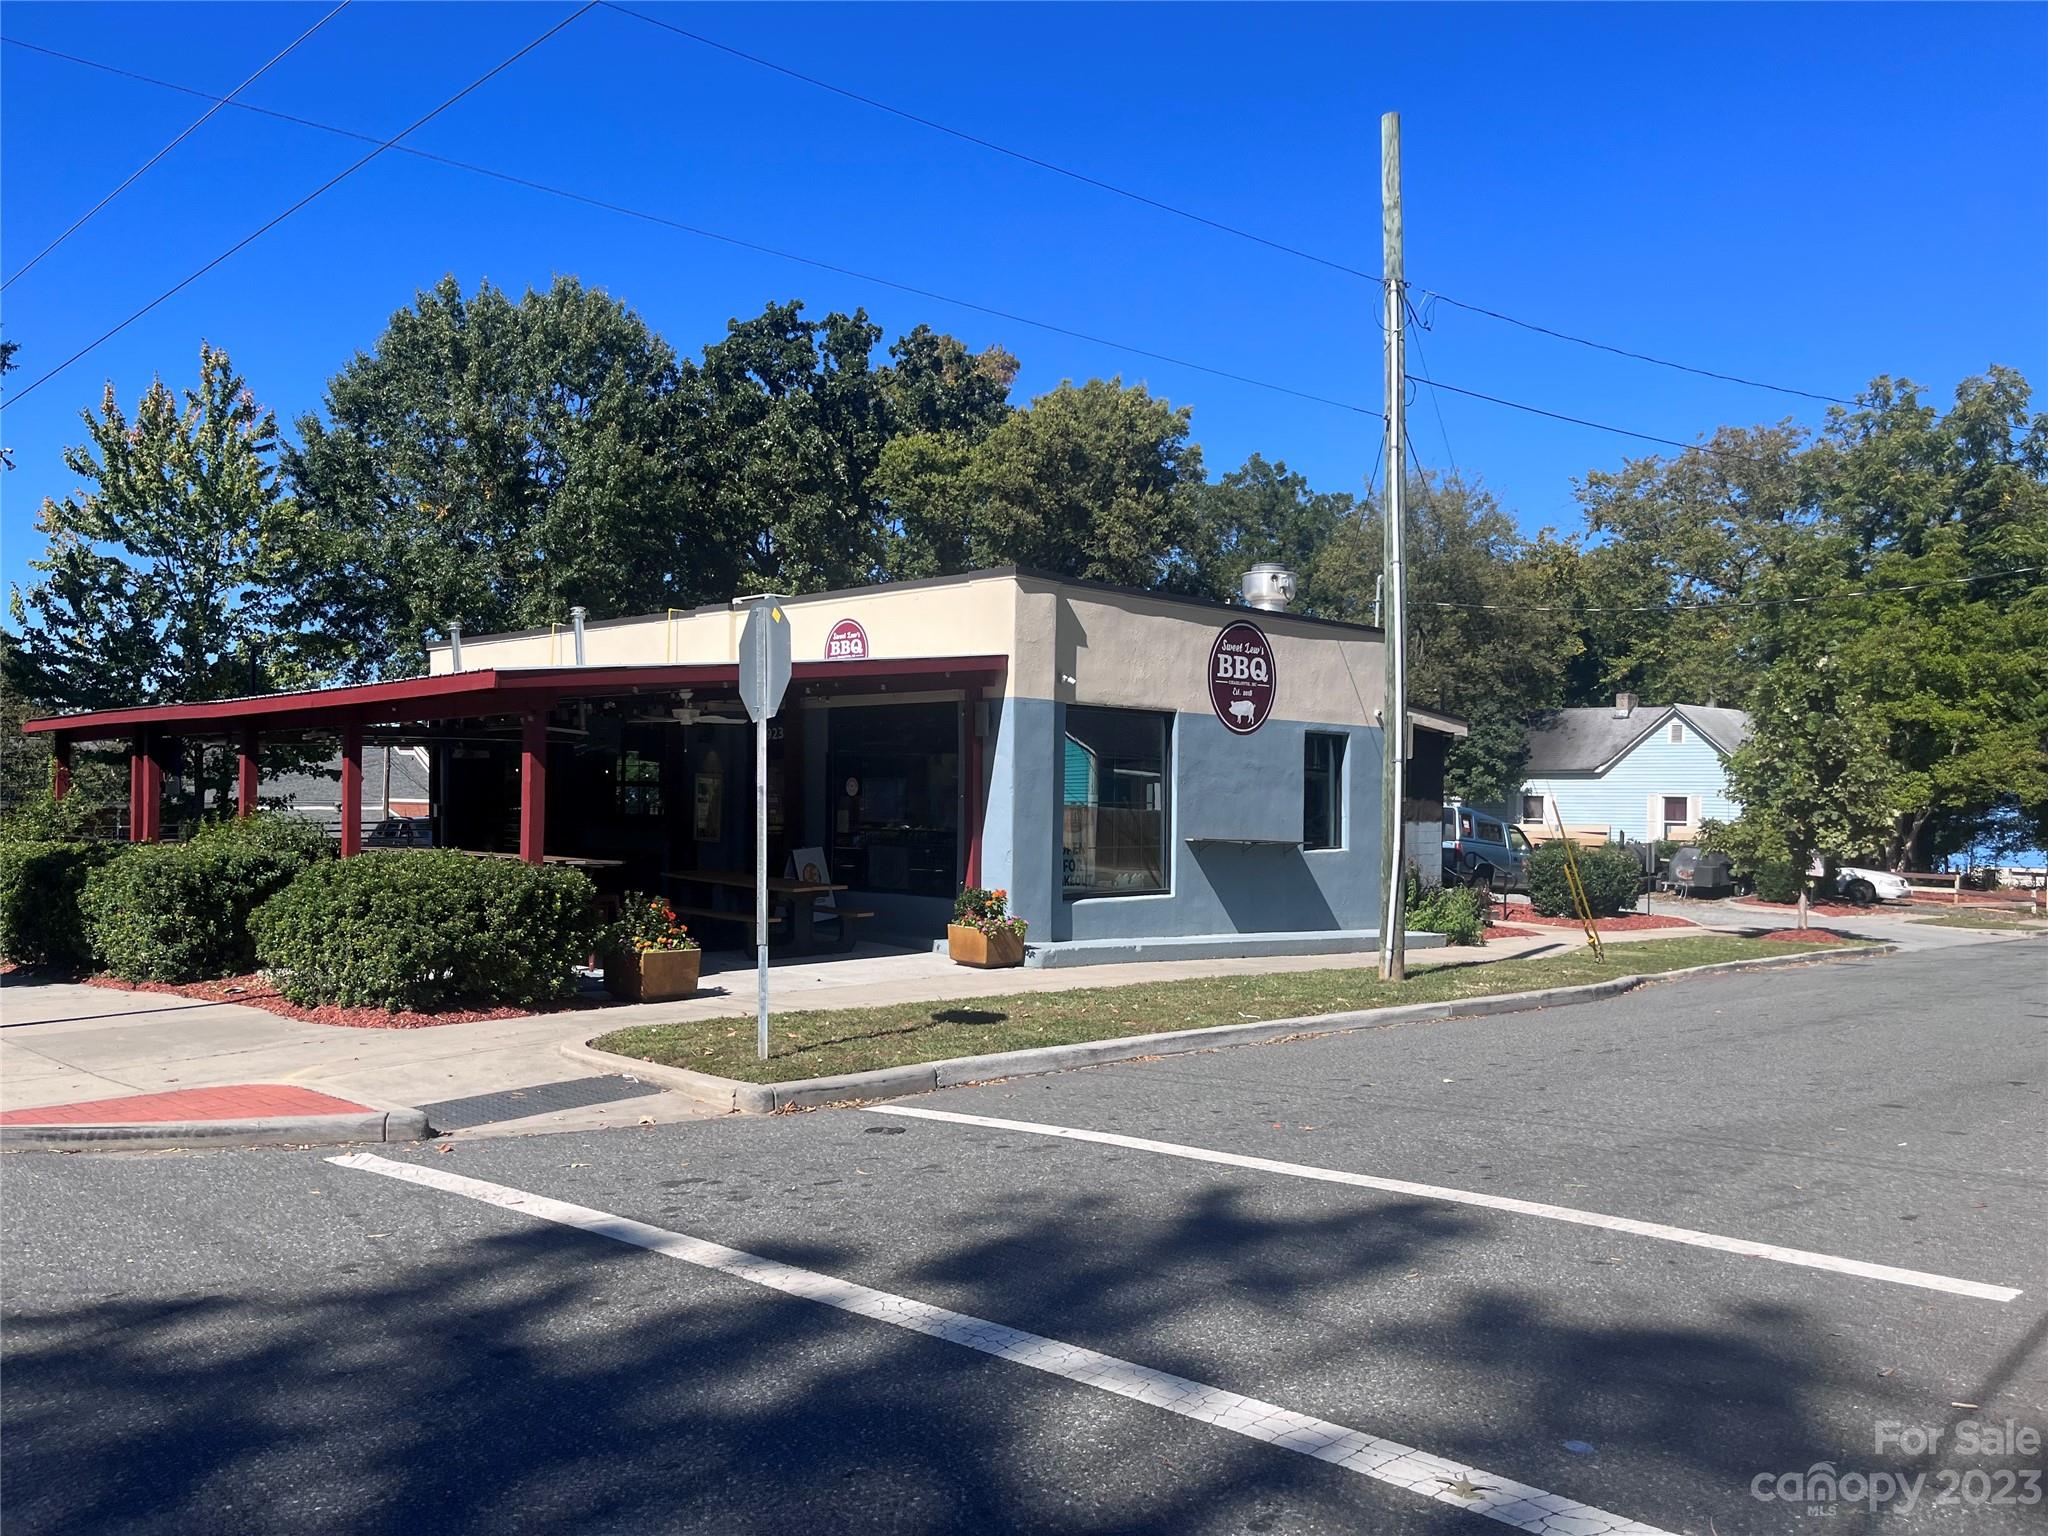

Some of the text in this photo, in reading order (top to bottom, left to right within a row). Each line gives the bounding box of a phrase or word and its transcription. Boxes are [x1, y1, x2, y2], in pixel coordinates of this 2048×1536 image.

[830, 639, 863, 655] BBQ
[1221, 639, 1243, 653] Sweet
[1217, 653, 1269, 683] BBQ
